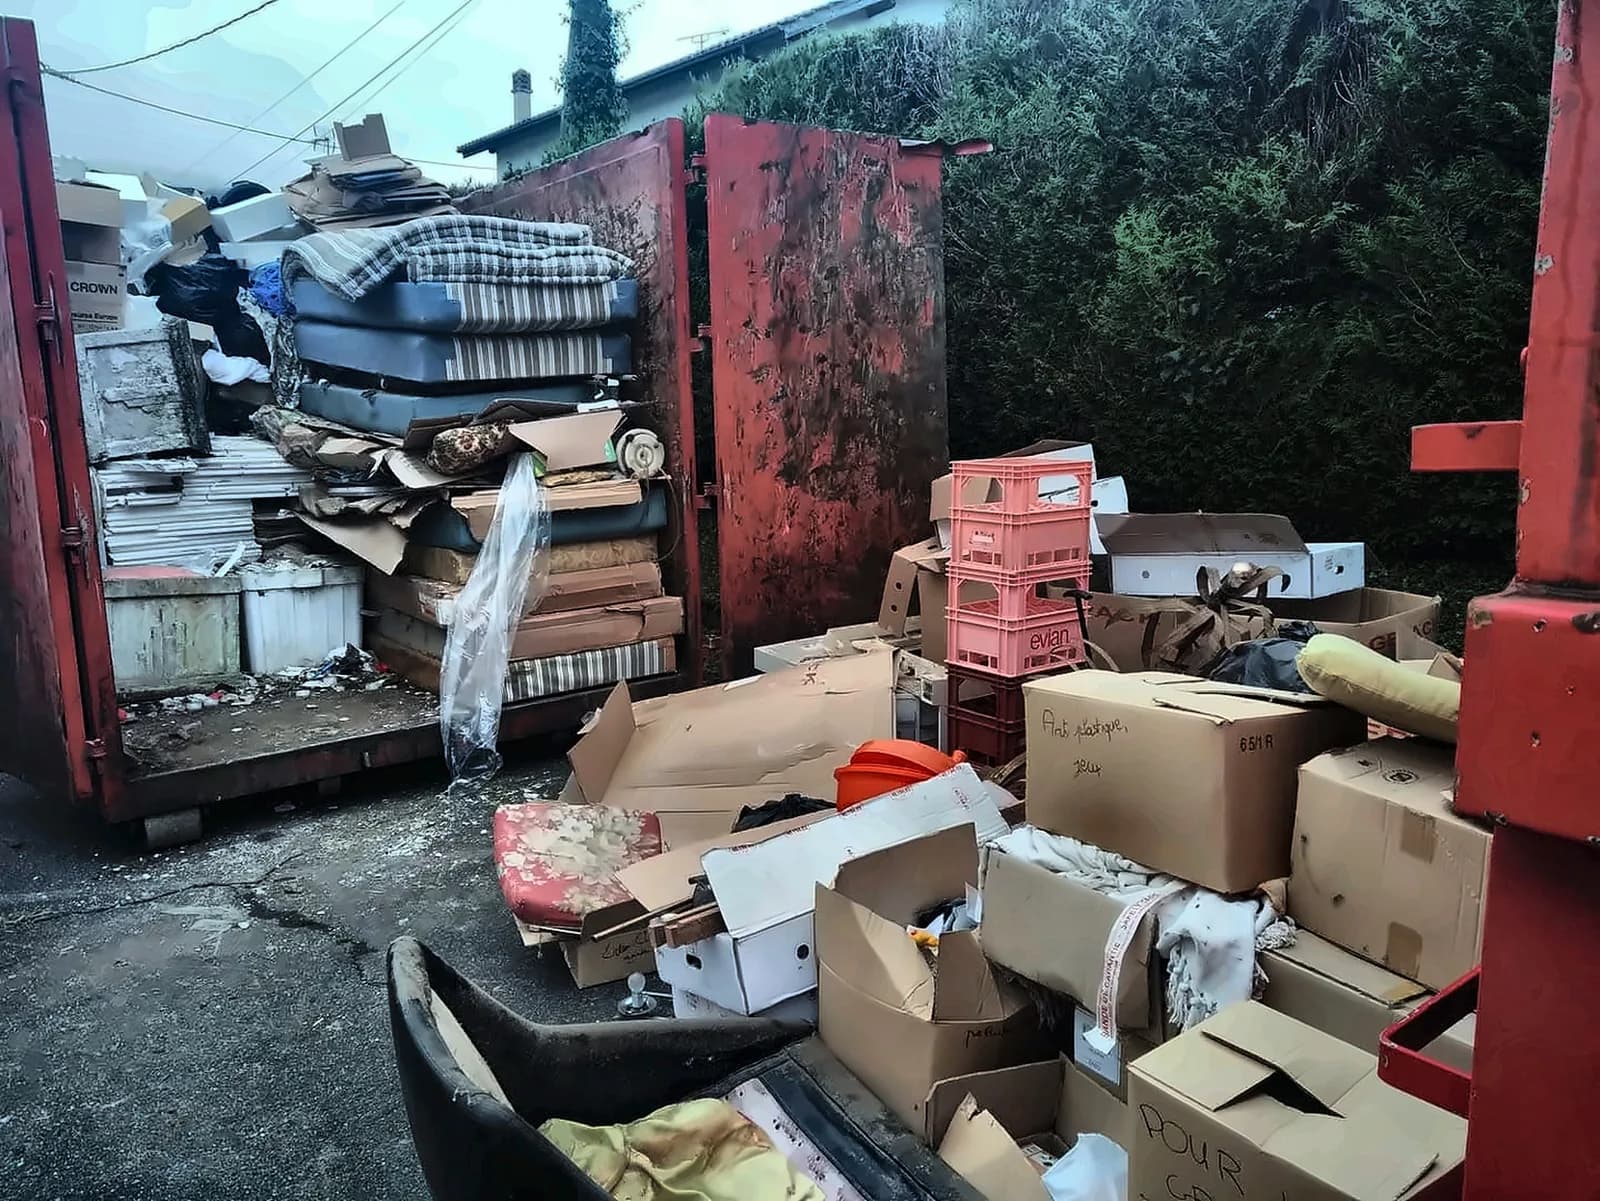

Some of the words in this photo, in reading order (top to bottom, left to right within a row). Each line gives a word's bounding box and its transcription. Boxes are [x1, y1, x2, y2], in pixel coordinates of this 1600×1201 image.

[70, 281, 118, 294] CROWN
[1030, 628, 1069, 650] evian
[1139, 1103, 1245, 1196] POUR
